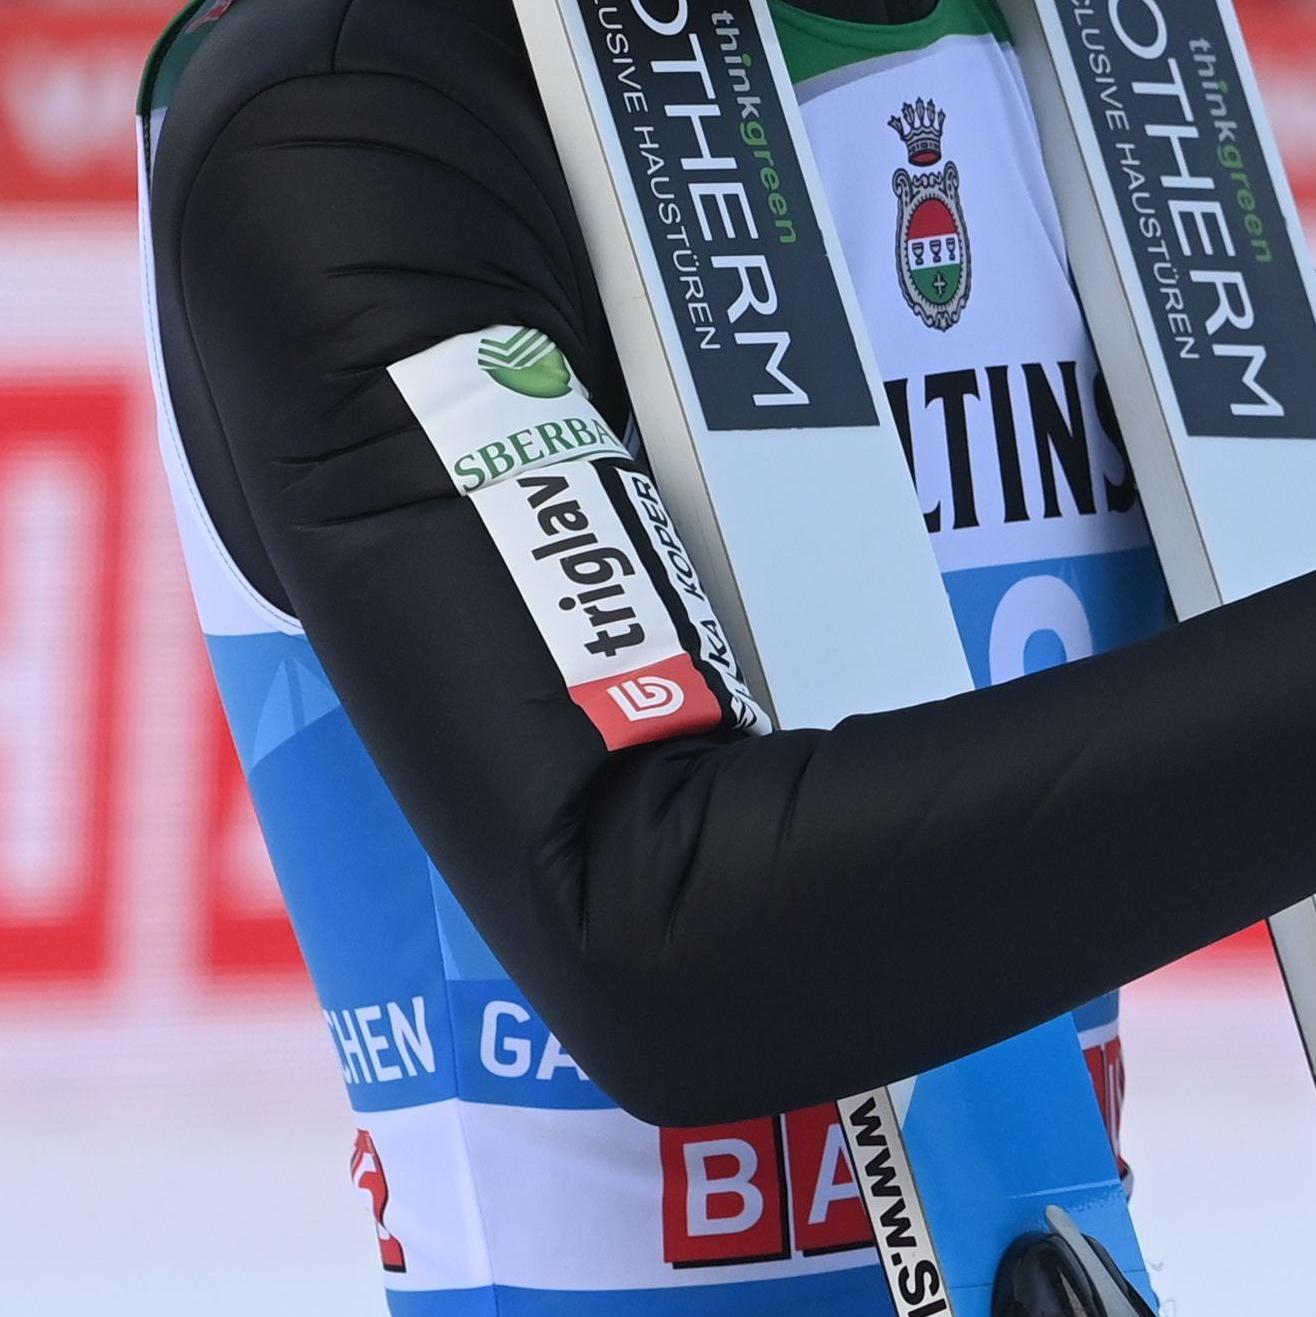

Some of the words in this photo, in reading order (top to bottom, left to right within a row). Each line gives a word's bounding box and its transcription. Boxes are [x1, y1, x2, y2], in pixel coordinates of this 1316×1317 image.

[711, 10, 797, 244] thinkgreen
[1189, 38, 1273, 264] thinkgreen
[633, 126, 721, 350] HAUSTÜREN
[1115, 142, 1200, 359] HAUSTÜREN
[516, 475, 646, 658] triglav
[637, 475, 705, 602] KOPER
